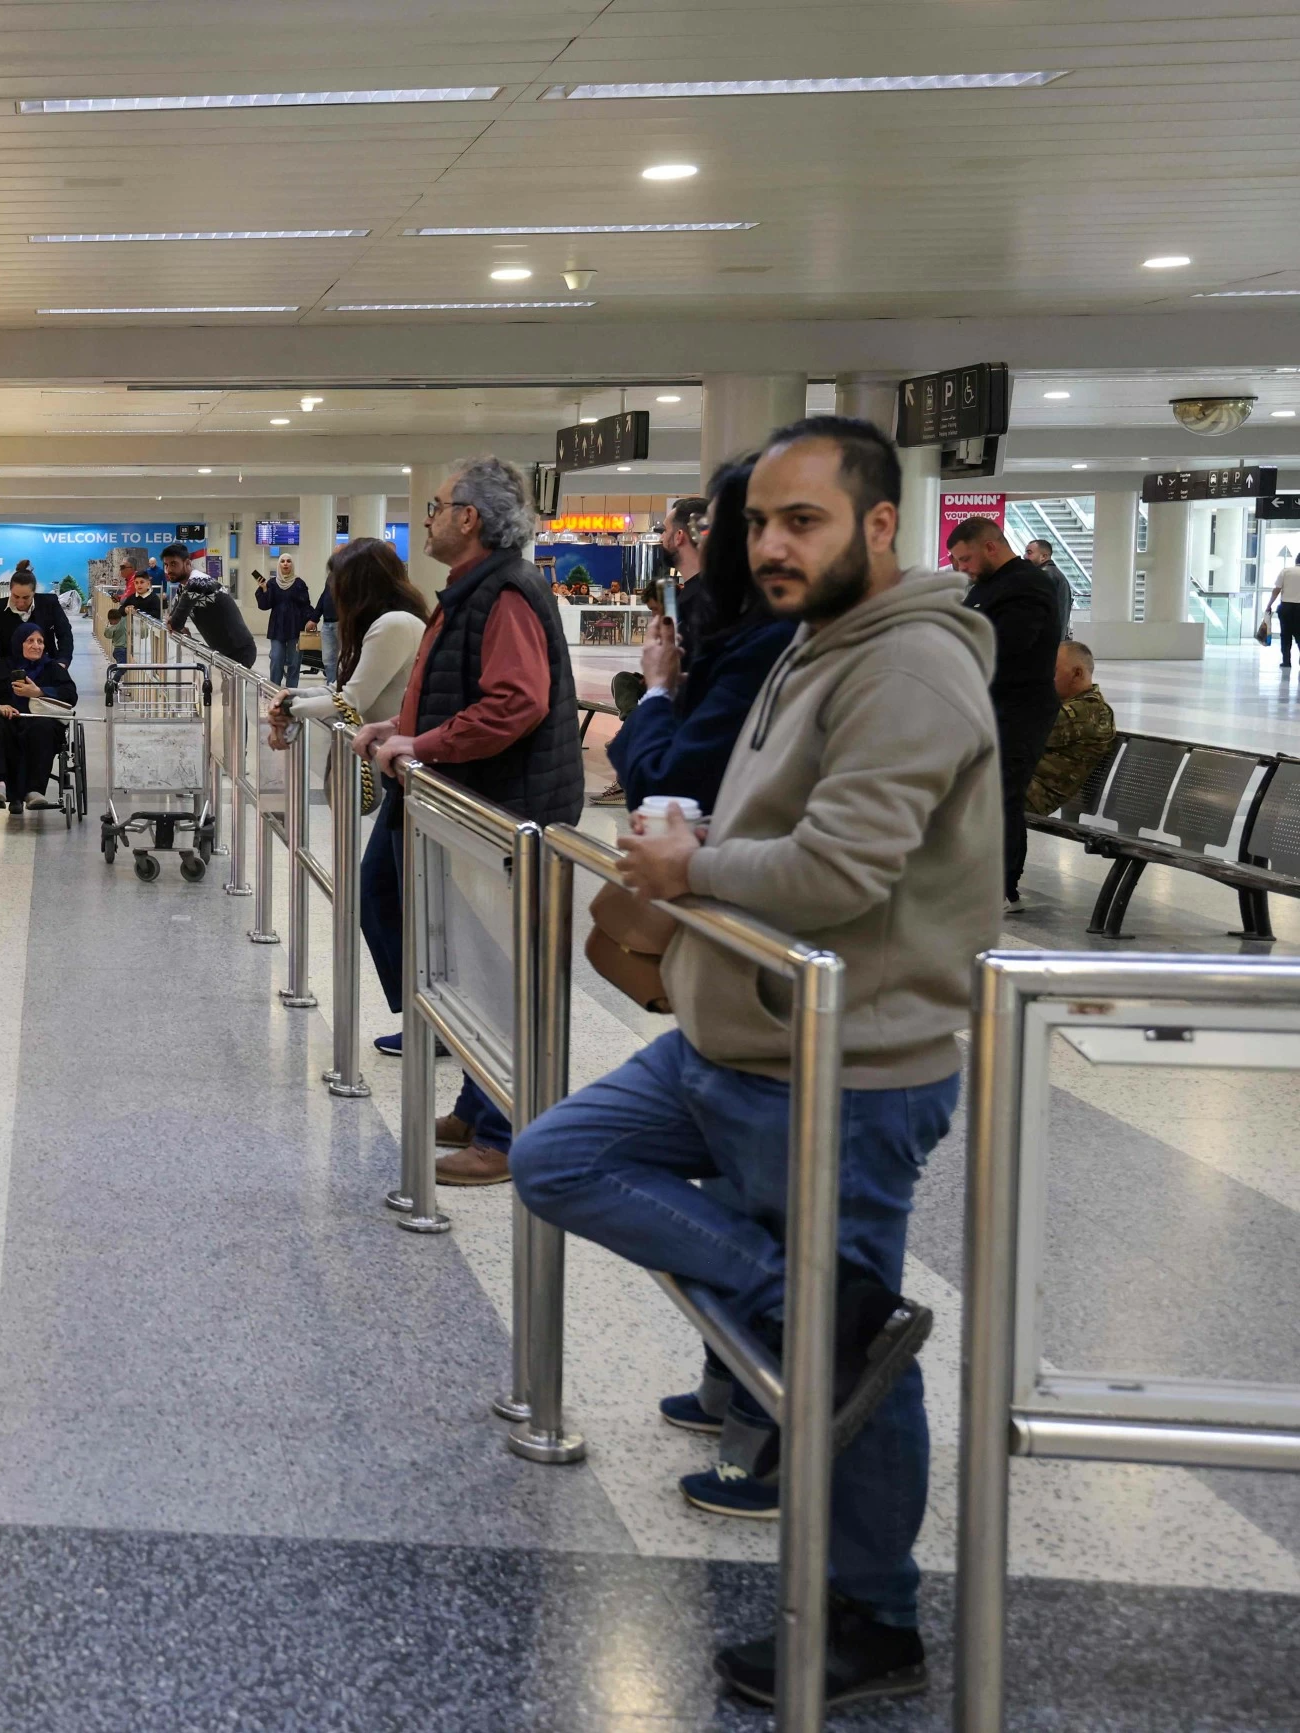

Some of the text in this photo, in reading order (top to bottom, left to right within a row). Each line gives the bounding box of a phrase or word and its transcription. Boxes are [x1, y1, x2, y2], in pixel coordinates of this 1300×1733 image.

[945, 495, 1001, 506] DUNKIN'
[945, 512, 968, 520] YOUR
[42, 532, 118, 544] WELCOME
[121, 532, 141, 544] TO
